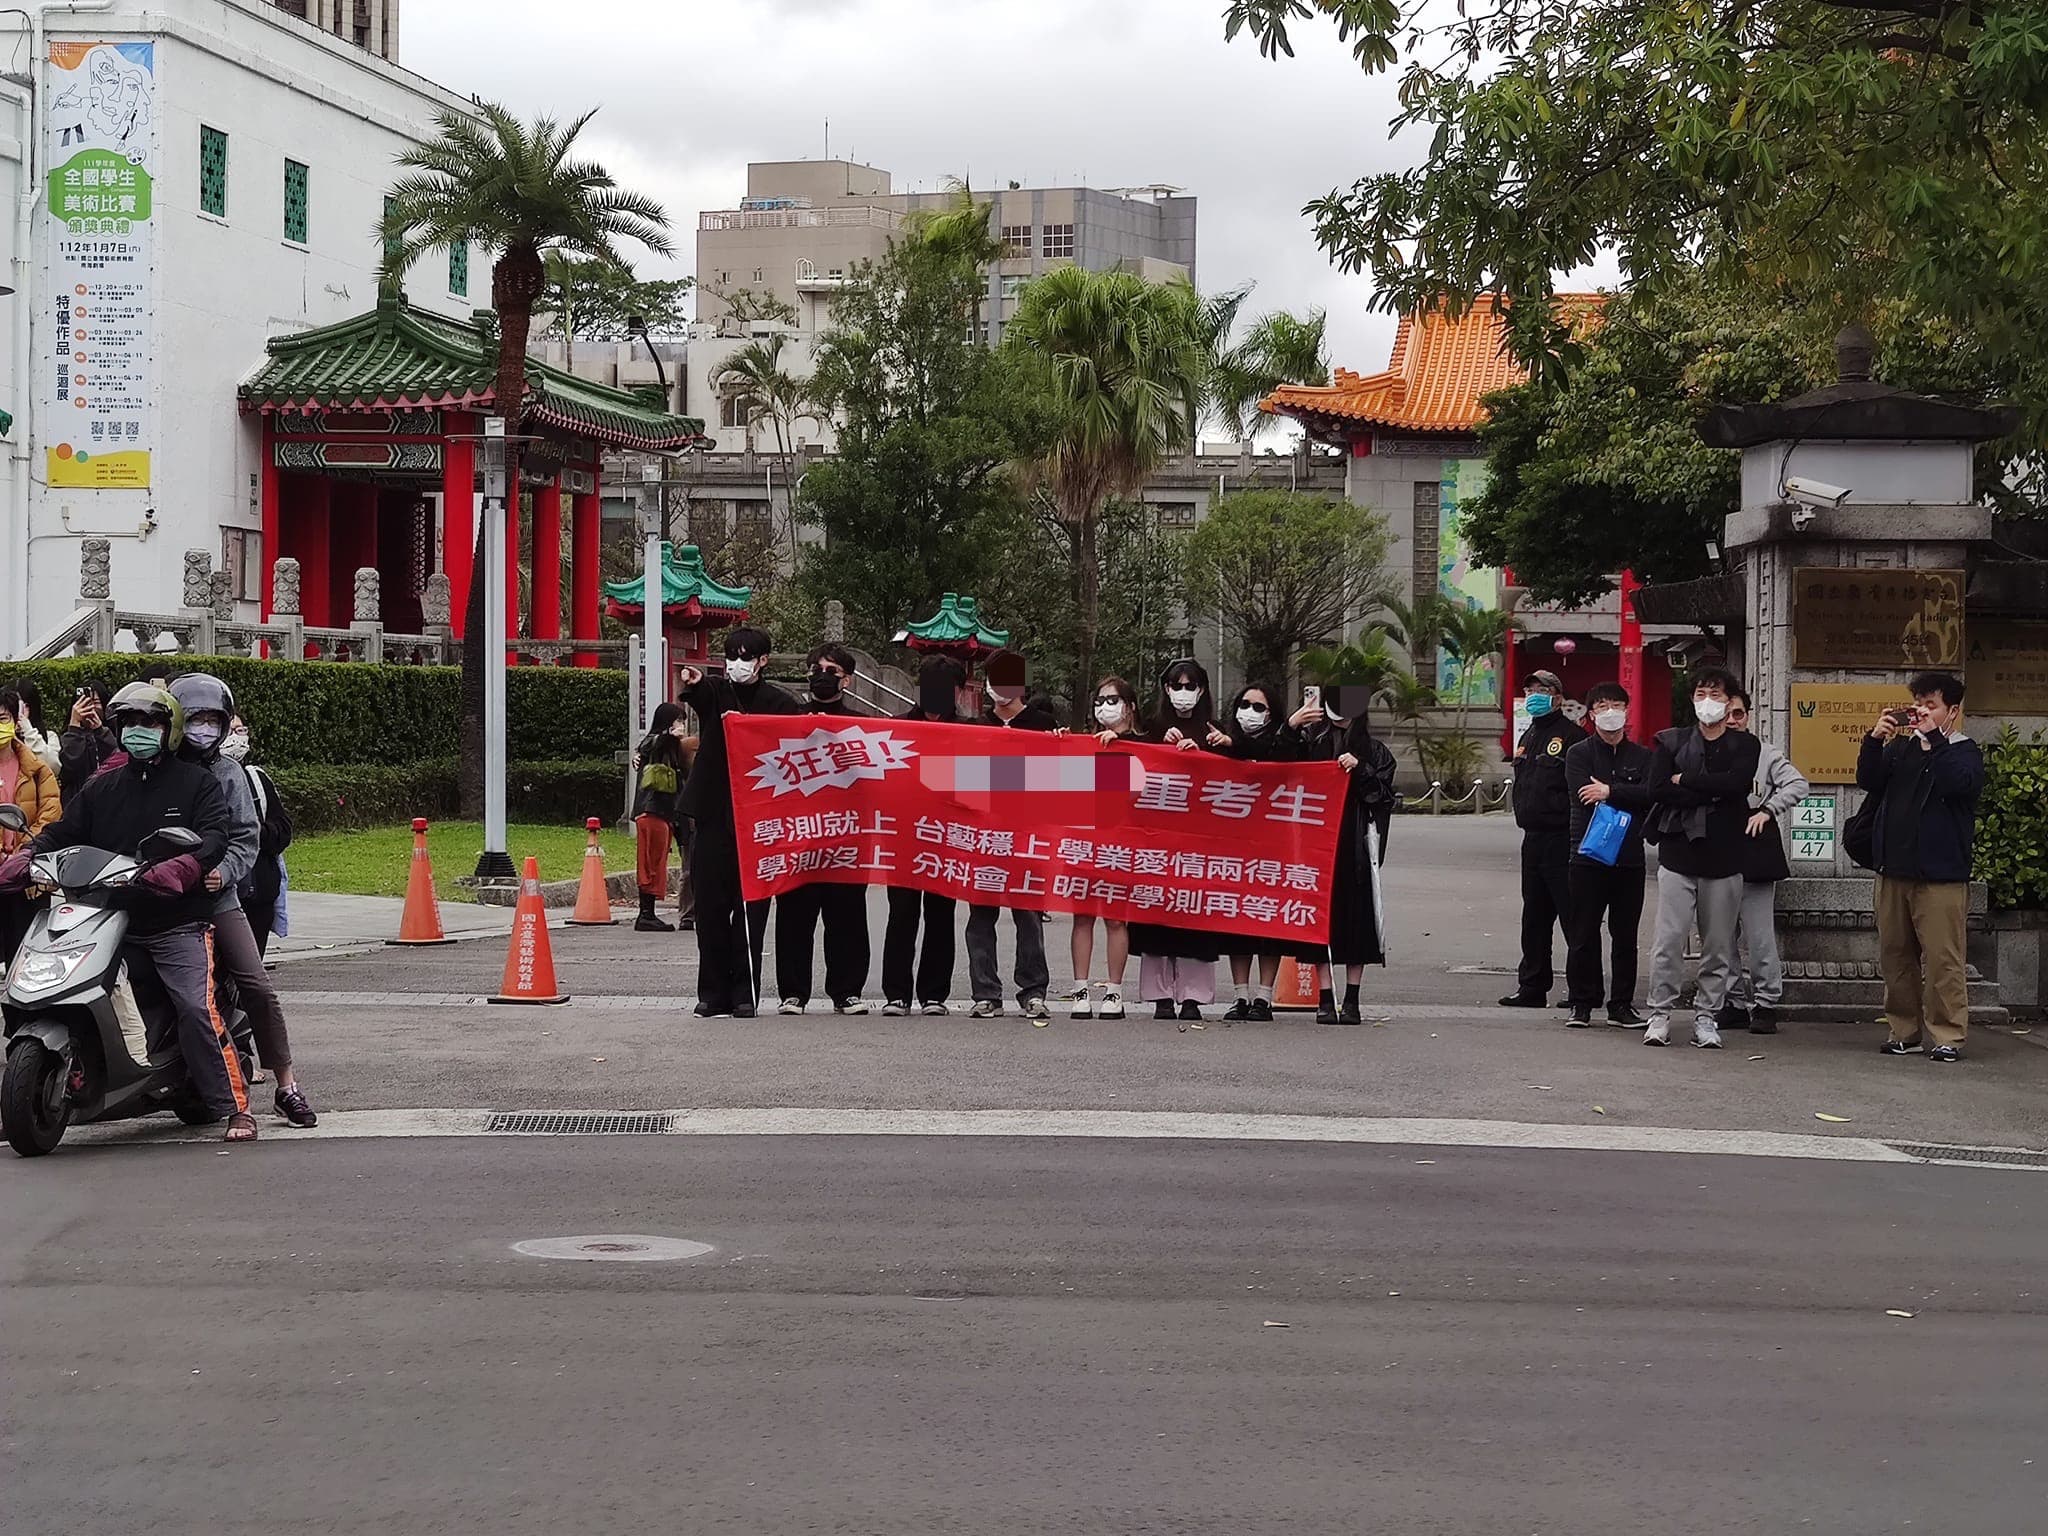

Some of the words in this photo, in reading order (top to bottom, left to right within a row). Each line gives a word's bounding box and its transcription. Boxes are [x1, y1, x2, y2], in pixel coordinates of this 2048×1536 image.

[64, 168, 136, 187] 全國學生
[64, 194, 137, 212] 美術比賽
[68, 218, 131, 234] 頒獎典禮
[1800, 809, 1825, 824] 43
[1800, 841, 1825, 857] 47
